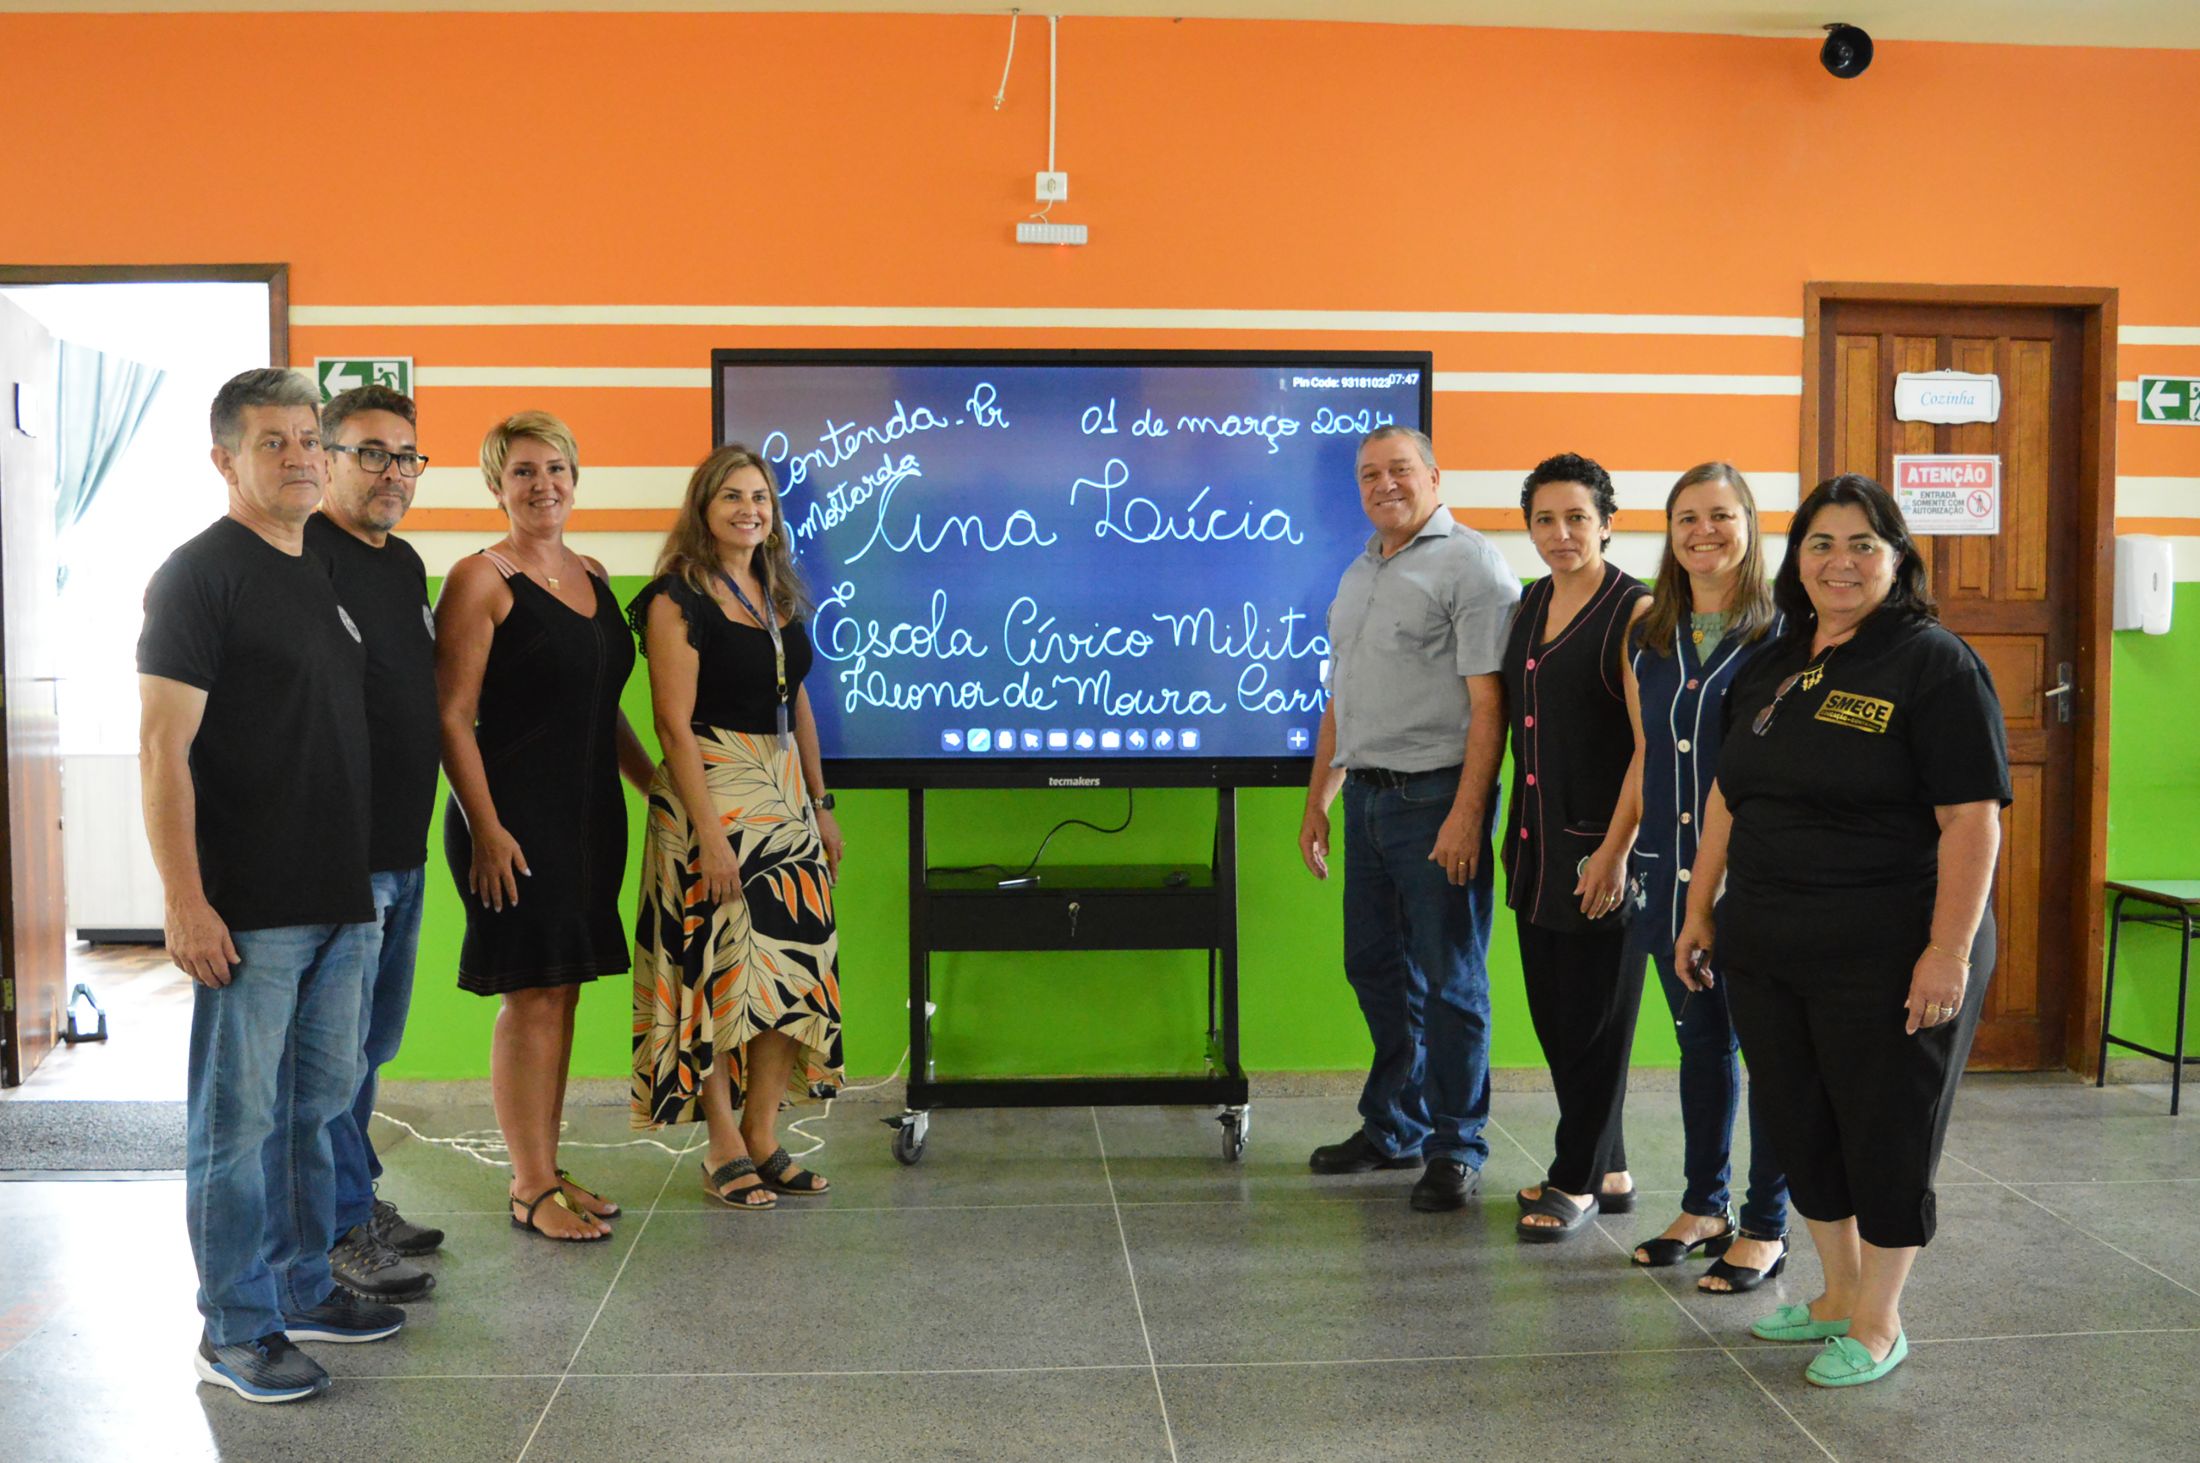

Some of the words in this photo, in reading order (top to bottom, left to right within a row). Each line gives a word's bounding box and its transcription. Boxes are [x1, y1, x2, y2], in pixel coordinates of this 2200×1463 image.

[1292, 377, 1309, 388] Pin
[1310, 377, 1339, 388] Code:
[1388, 373, 1419, 385] 07:47
[1920, 390, 1975, 406] Cozinha
[1081, 398, 1119, 435] 01
[1131, 408, 1170, 437] de
[1177, 414, 1301, 454] março
[1310, 407, 1395, 435] 2024
[1907, 464, 1986, 487] ATENÇÃO
[1069, 457, 1304, 544] Lúcia
[1912, 499, 1946, 507] SOMENTE
[1947, 499, 1965, 507] COM
[1920, 491, 1957, 499] ENTRADA
[1912, 507, 1964, 516] AUTORIZAÇÃO
[812, 581, 988, 661] Escola
[1004, 596, 1154, 667] Cívico
[840, 655, 1000, 713] Leonor
[1003, 671, 1058, 710] de
[1052, 669, 1227, 716] Moura
[1825, 695, 1889, 722] SMECE
[1048, 776, 1100, 786] tecmakers
